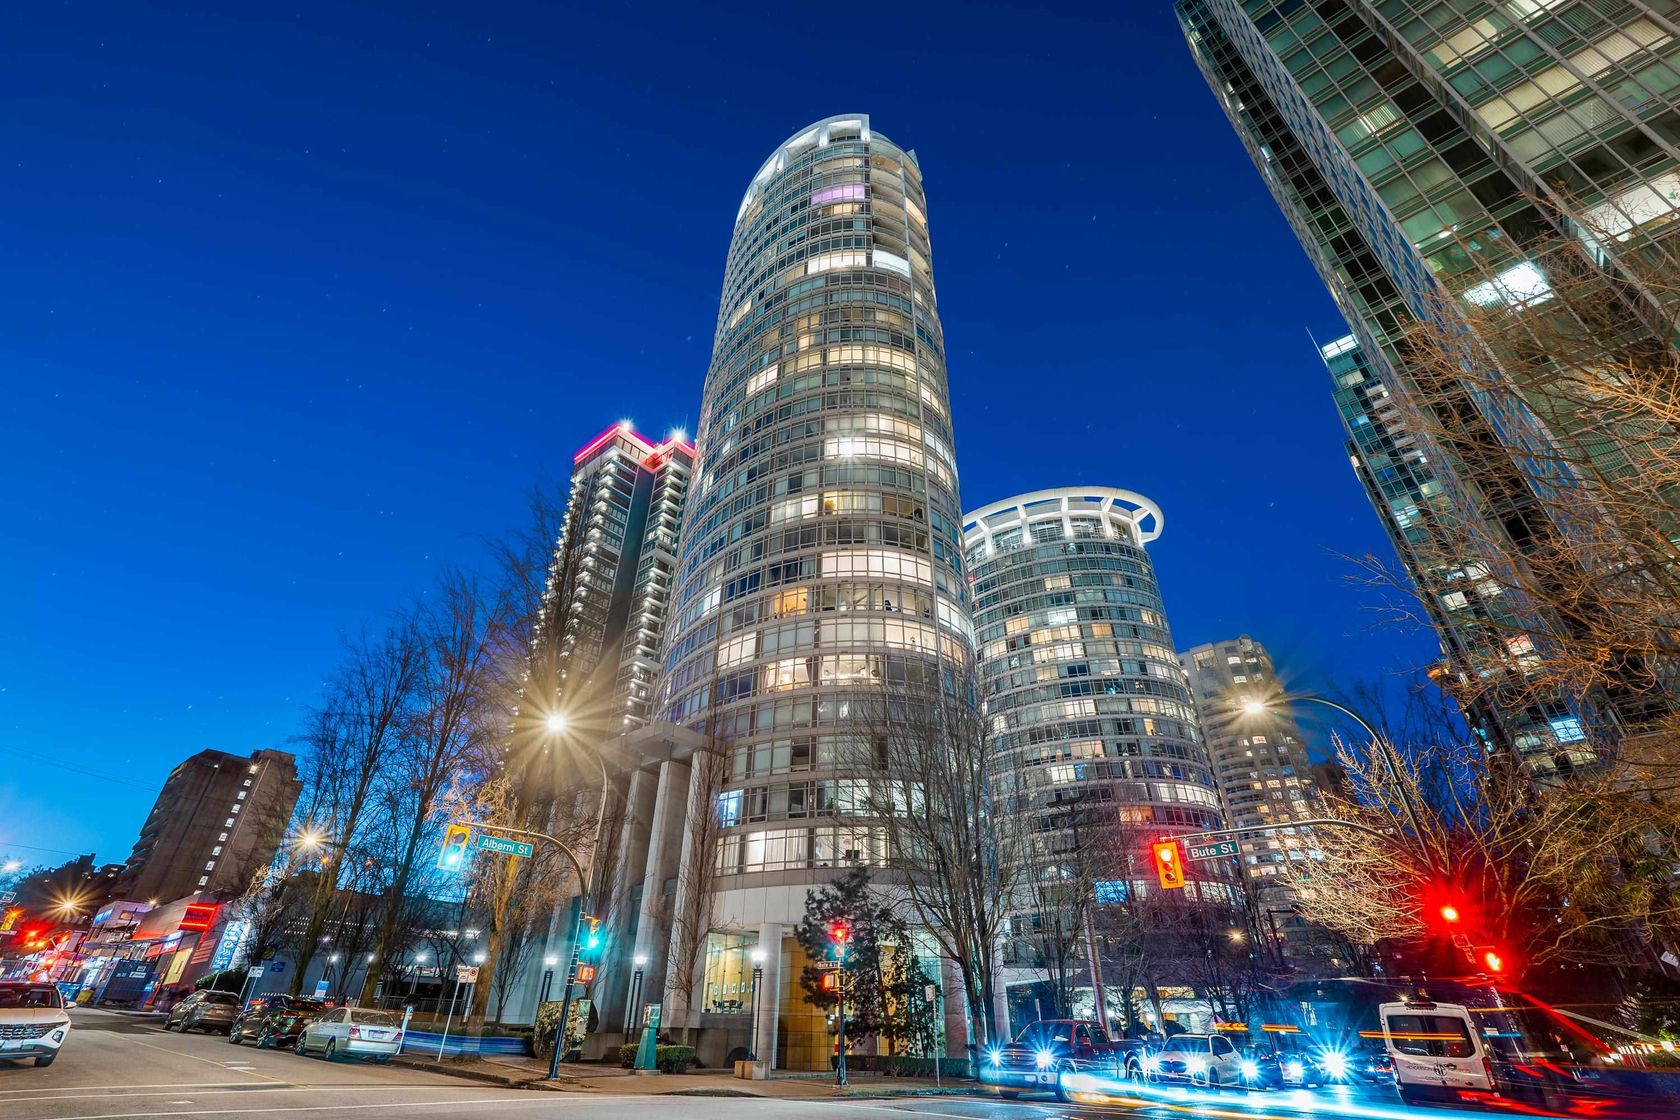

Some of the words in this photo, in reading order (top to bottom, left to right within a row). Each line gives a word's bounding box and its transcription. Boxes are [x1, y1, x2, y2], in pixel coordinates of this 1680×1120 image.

[481, 838, 515, 852] Alberni
[517, 845, 529, 855] St
[1190, 846, 1217, 859] Bute
[1220, 843, 1234, 854] St
